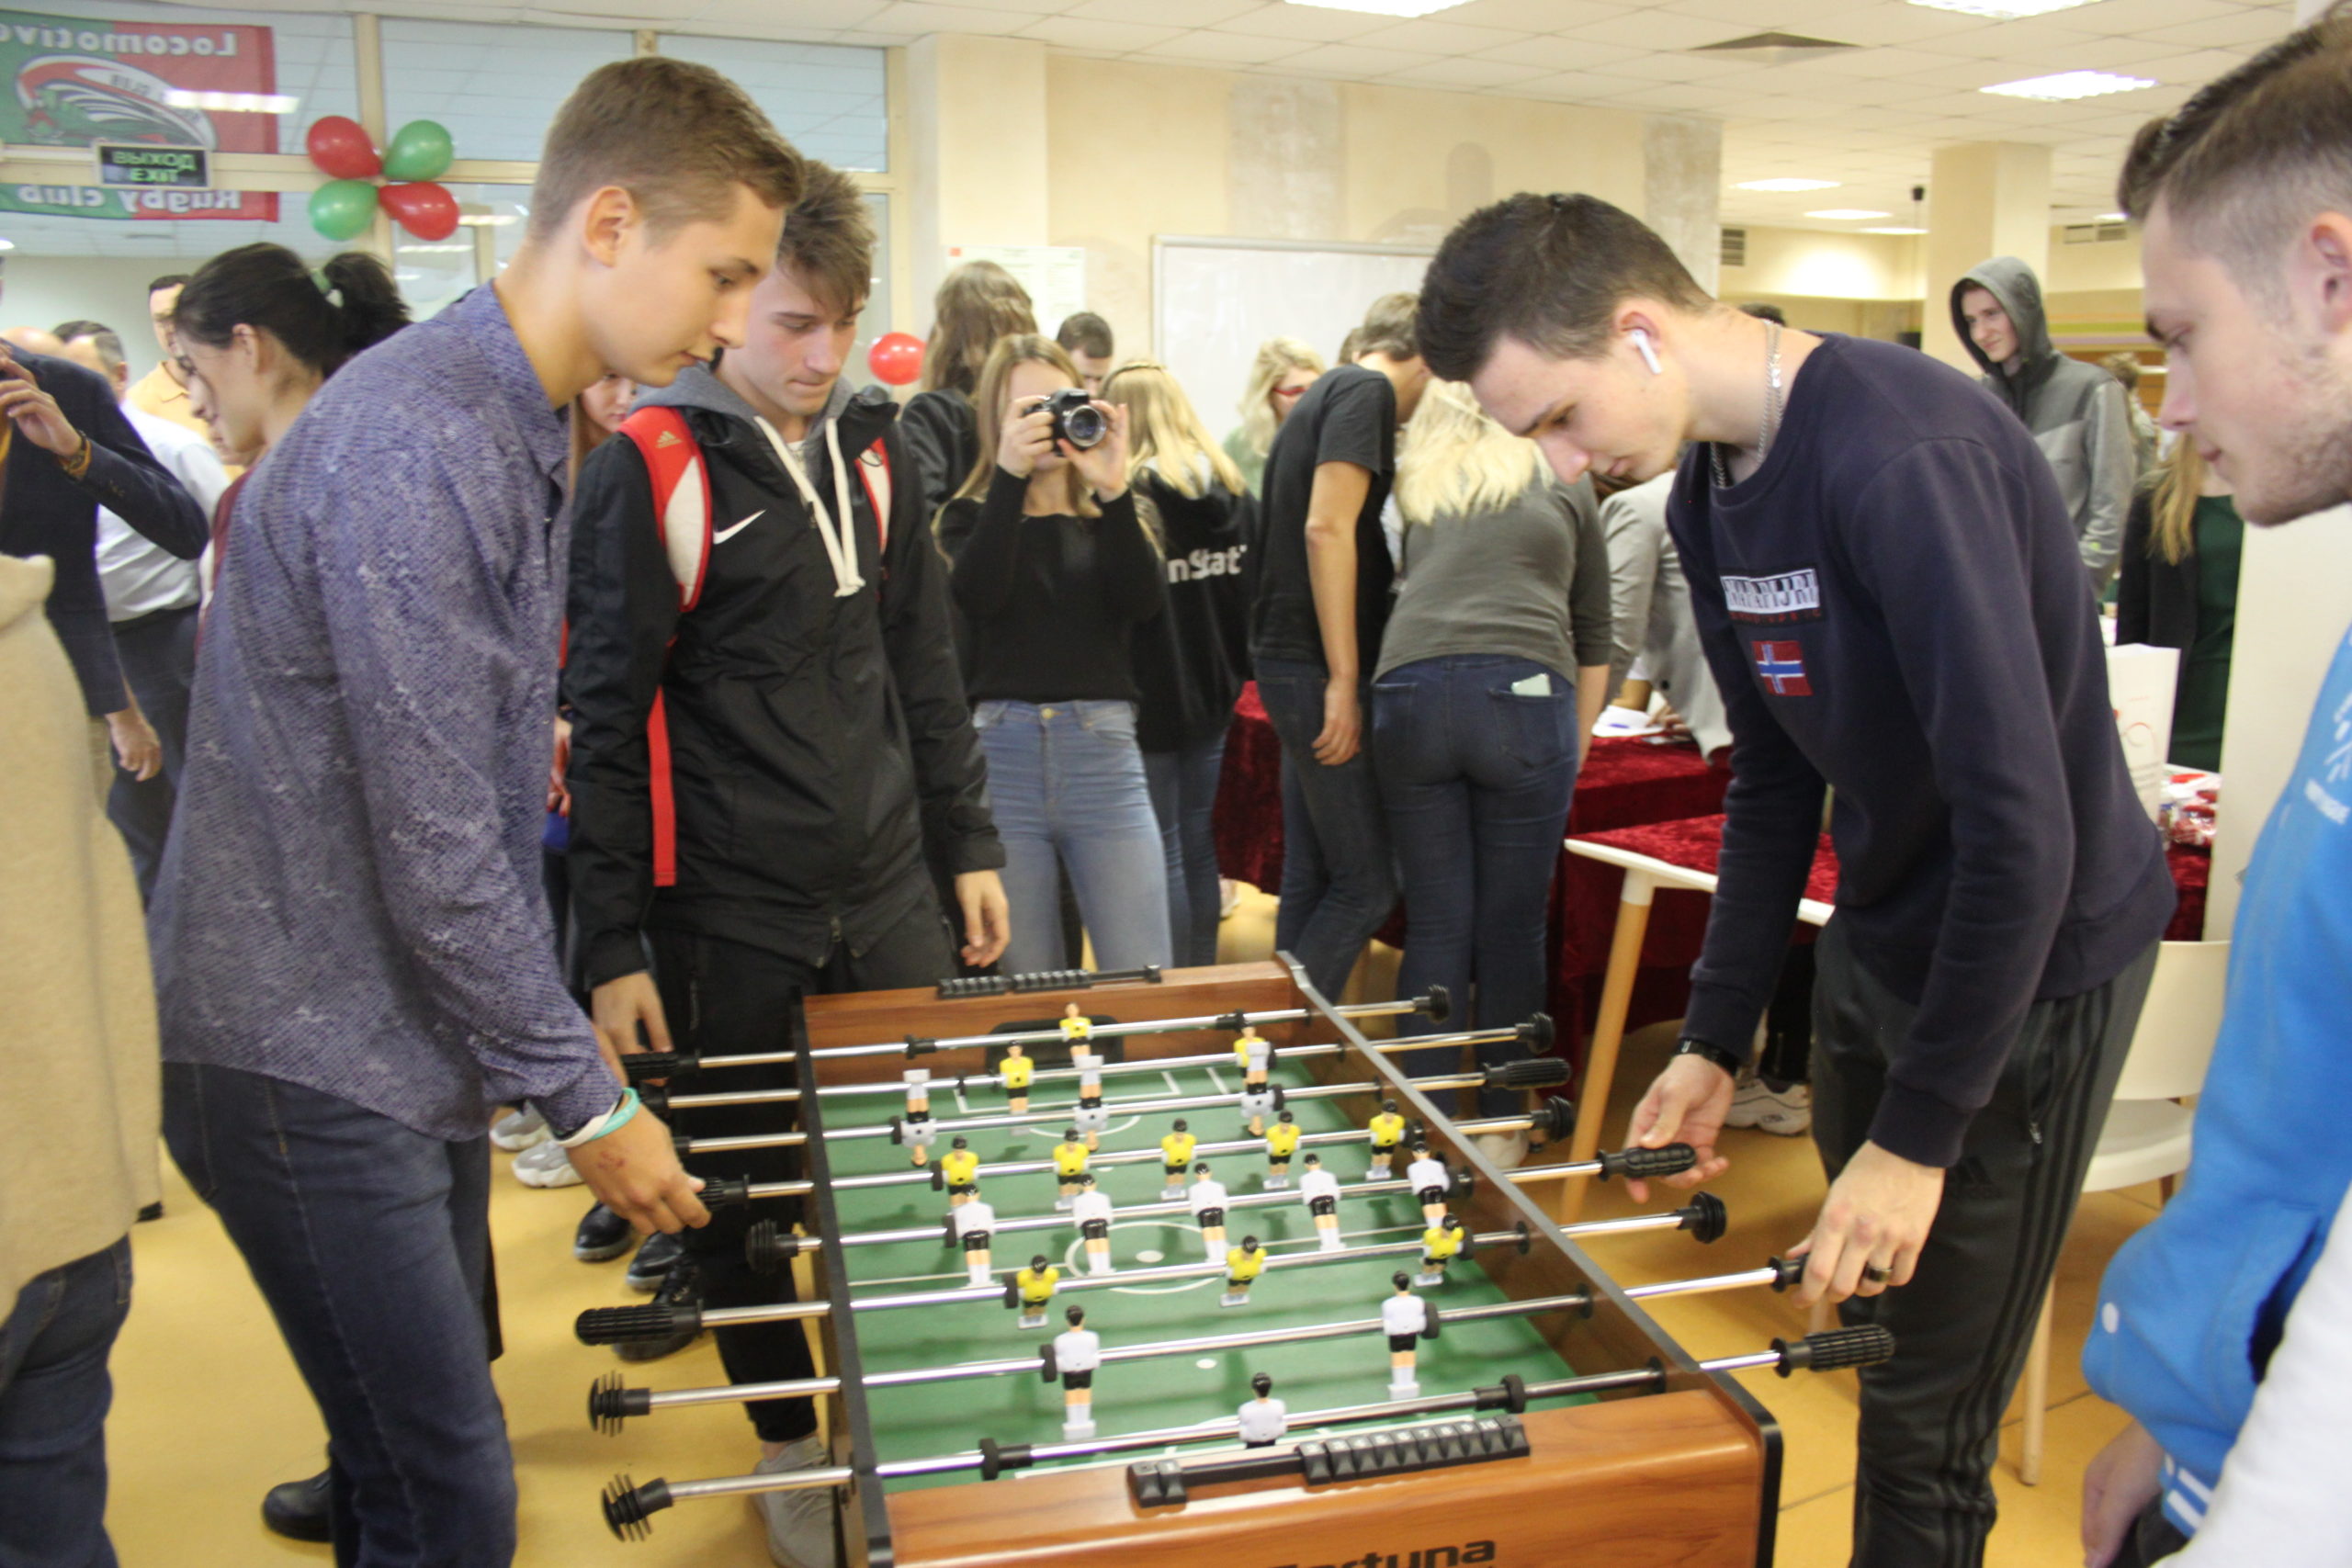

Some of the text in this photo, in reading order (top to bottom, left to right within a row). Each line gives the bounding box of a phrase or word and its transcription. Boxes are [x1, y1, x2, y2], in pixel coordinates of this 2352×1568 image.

[112, 151, 197, 172] ВЫХОД
[130, 168, 178, 182] EXIT
[1268, 1540, 1497, 1568] tuna
